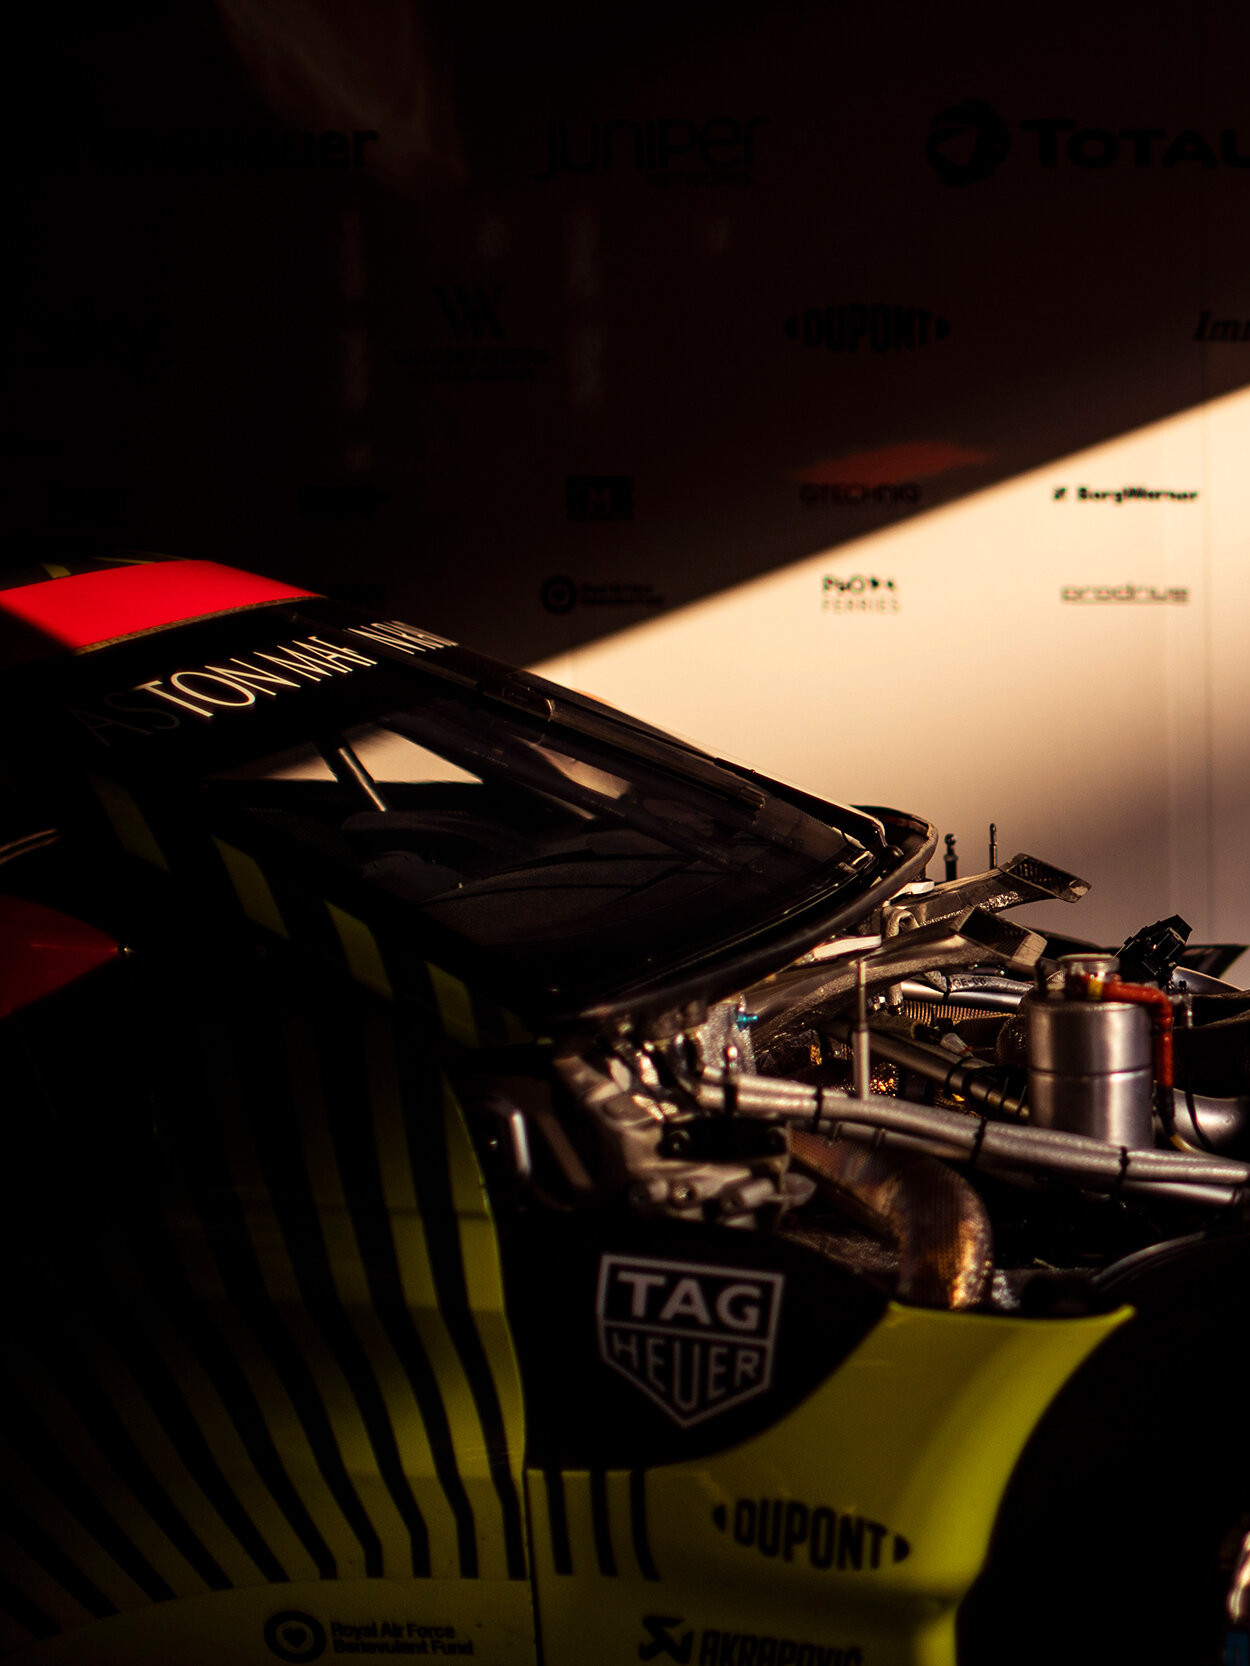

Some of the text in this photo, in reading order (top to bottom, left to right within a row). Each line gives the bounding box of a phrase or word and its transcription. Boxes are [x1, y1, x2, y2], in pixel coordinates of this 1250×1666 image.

[804, 303, 932, 354] DUPONT
[66, 657, 302, 748] ASTON
[617, 1270, 761, 1331] TAG
[612, 1331, 760, 1411] HEUER
[733, 1497, 888, 1571] DUPONT
[330, 1621, 456, 1641] Royal Air Force
[332, 1638, 475, 1655] Benevolent Fund
